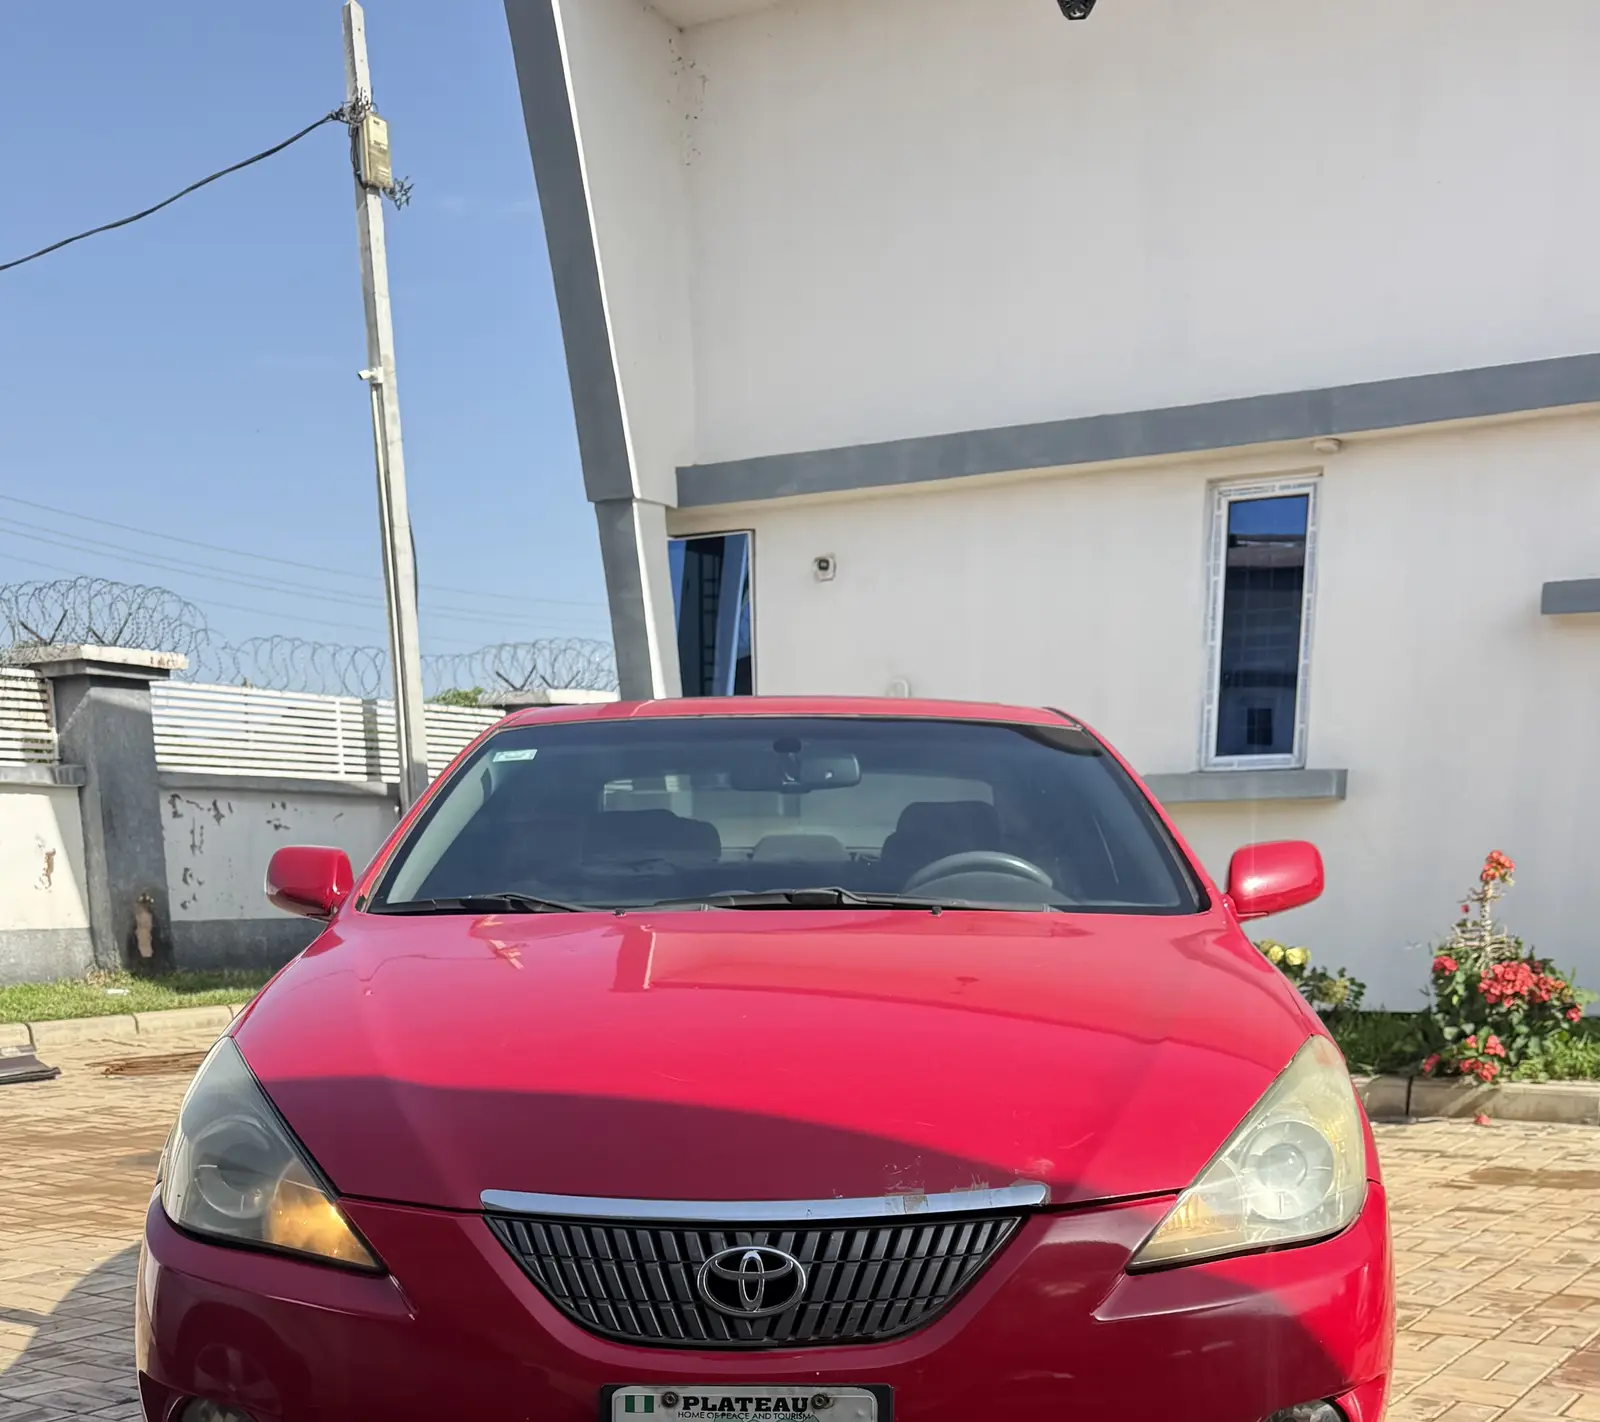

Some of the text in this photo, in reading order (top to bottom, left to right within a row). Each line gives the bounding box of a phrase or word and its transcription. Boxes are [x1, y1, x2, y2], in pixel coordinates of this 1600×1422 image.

[682, 1396, 809, 1412] PLATEAU
[678, 1411, 812, 1420] HOME OF PEACE AND TOURISM
